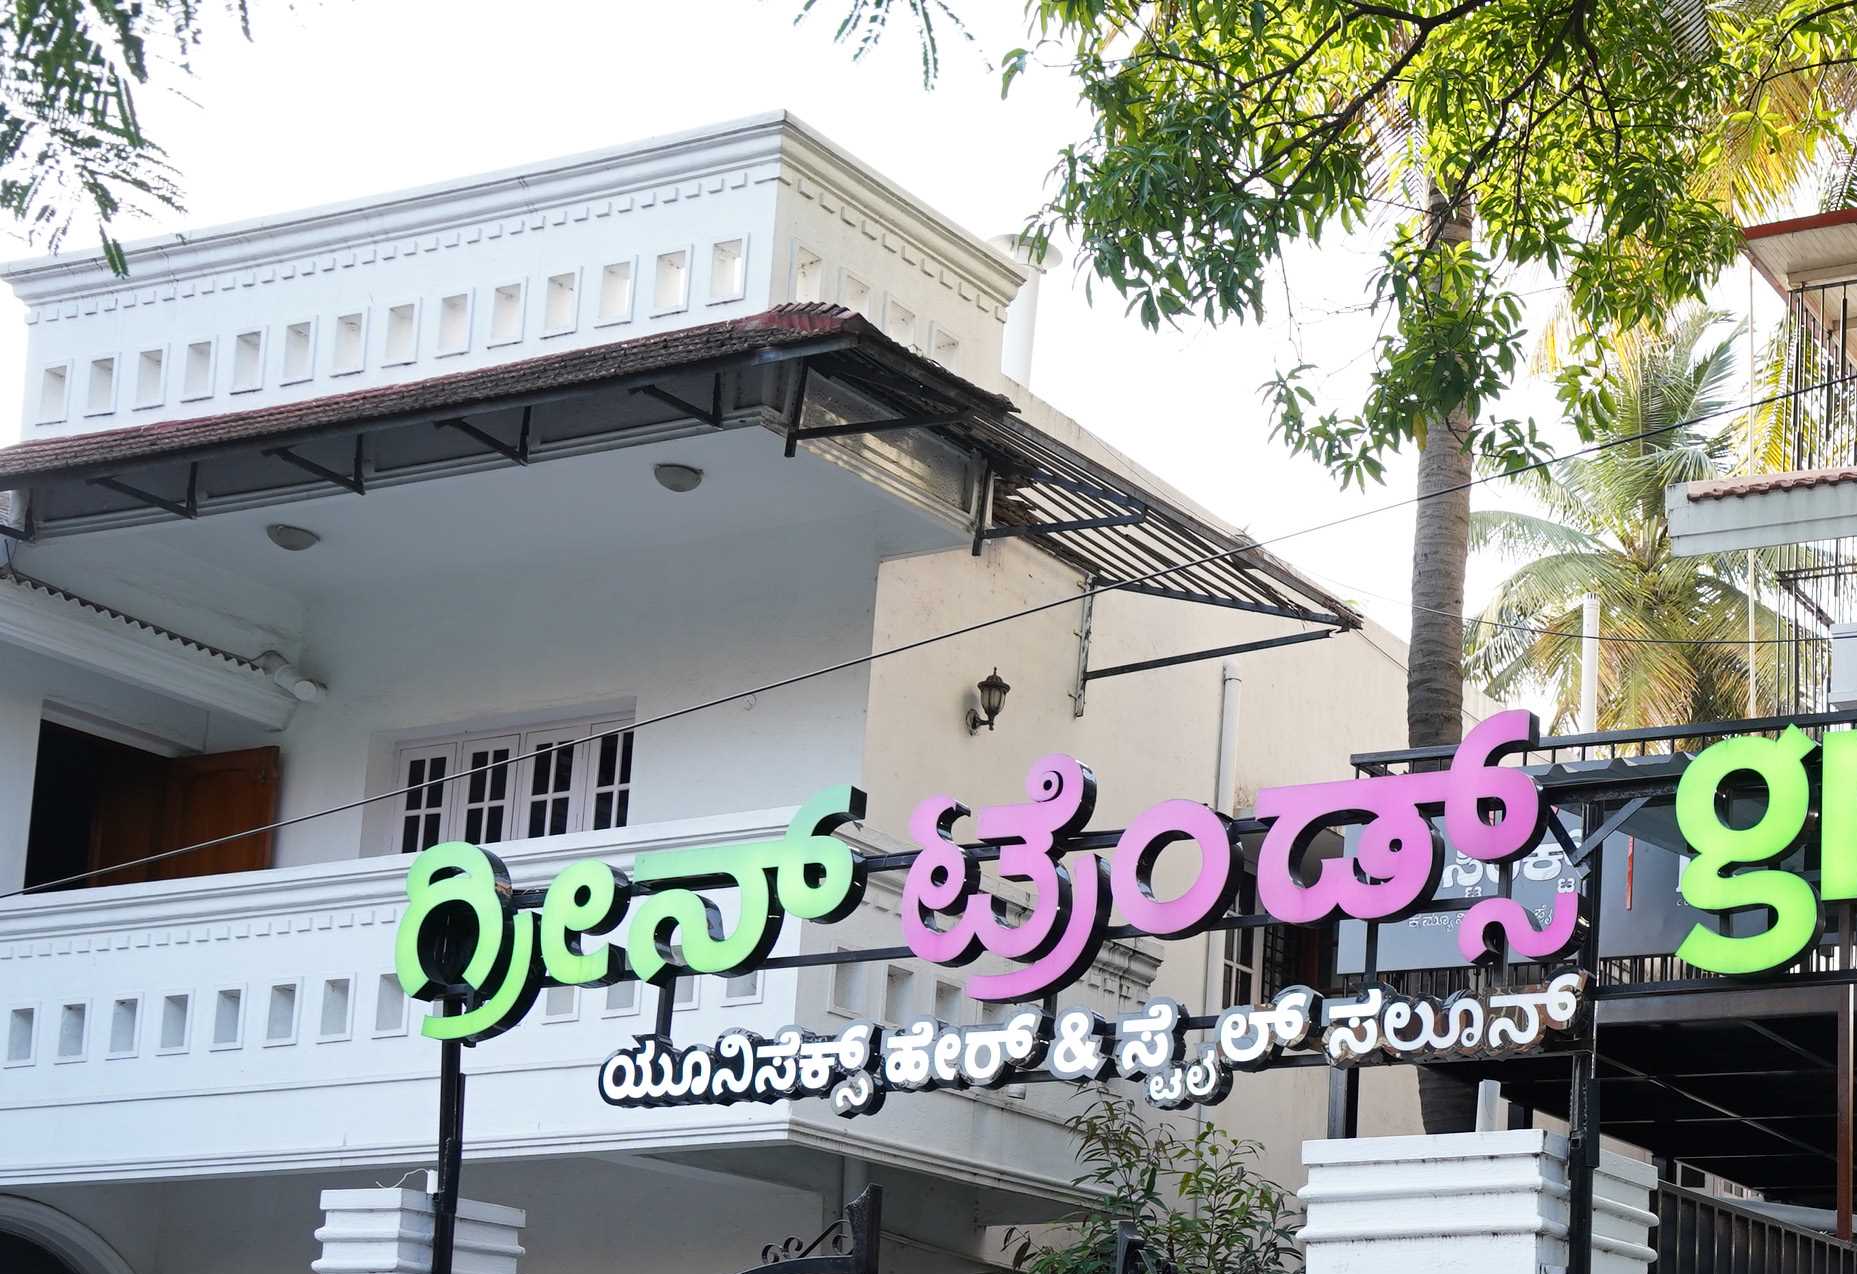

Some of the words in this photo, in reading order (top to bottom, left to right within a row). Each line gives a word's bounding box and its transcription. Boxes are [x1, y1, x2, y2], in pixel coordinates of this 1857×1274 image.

[395, 784, 858, 1040] ಗ್ರೀನ್
[886, 1013, 1036, 1085] ಹೇರ್
[1052, 1012, 1100, 1073] &
[1328, 973, 1583, 1057] ಸಲೂನ್
